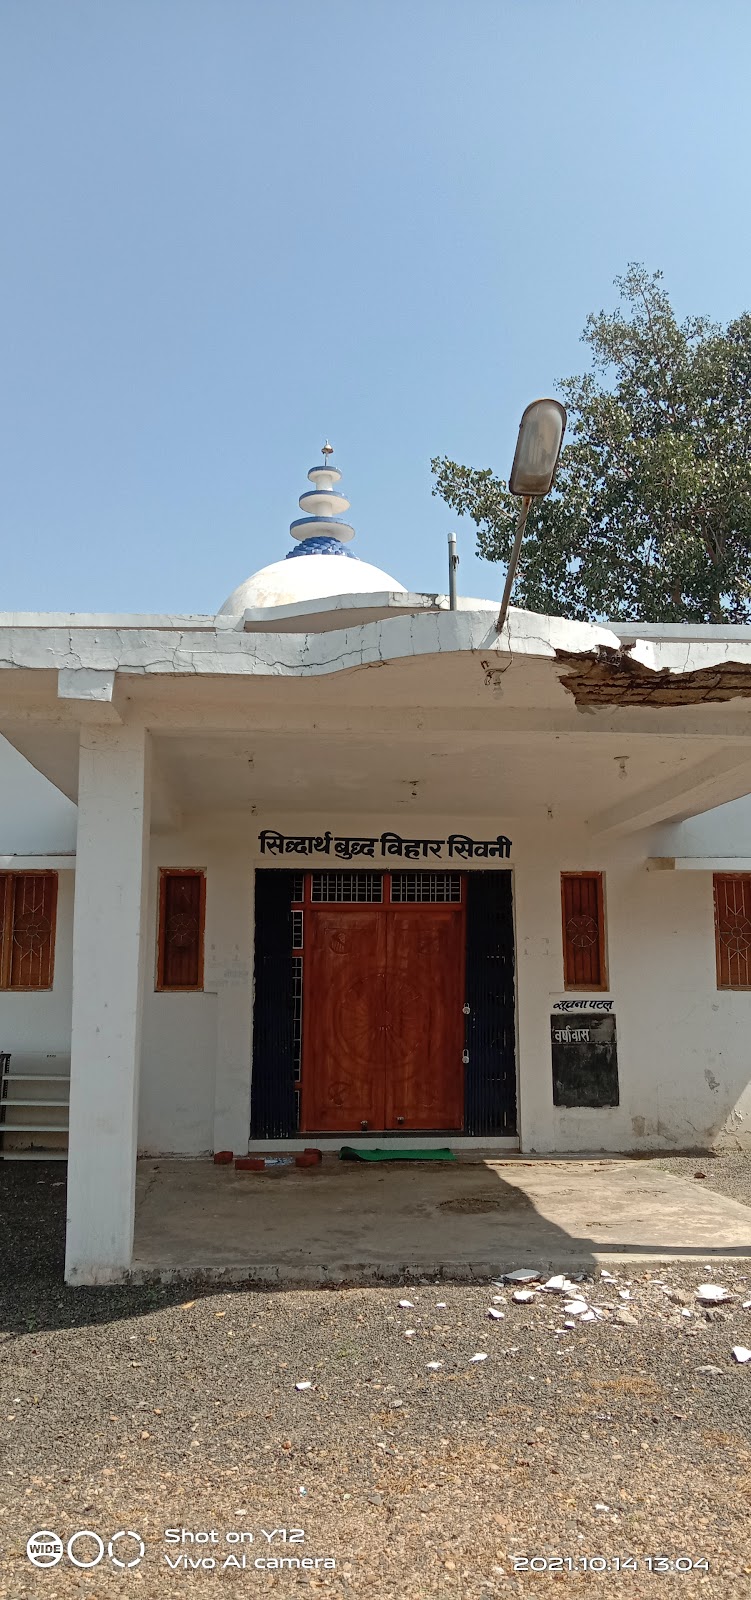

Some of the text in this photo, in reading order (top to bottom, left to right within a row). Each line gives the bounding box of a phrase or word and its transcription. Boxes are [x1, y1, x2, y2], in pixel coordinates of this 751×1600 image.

[380, 832, 445, 859] विहार
[447, 834, 512, 859] सिवनी
[554, 1025, 590, 1042] वर्षावास
